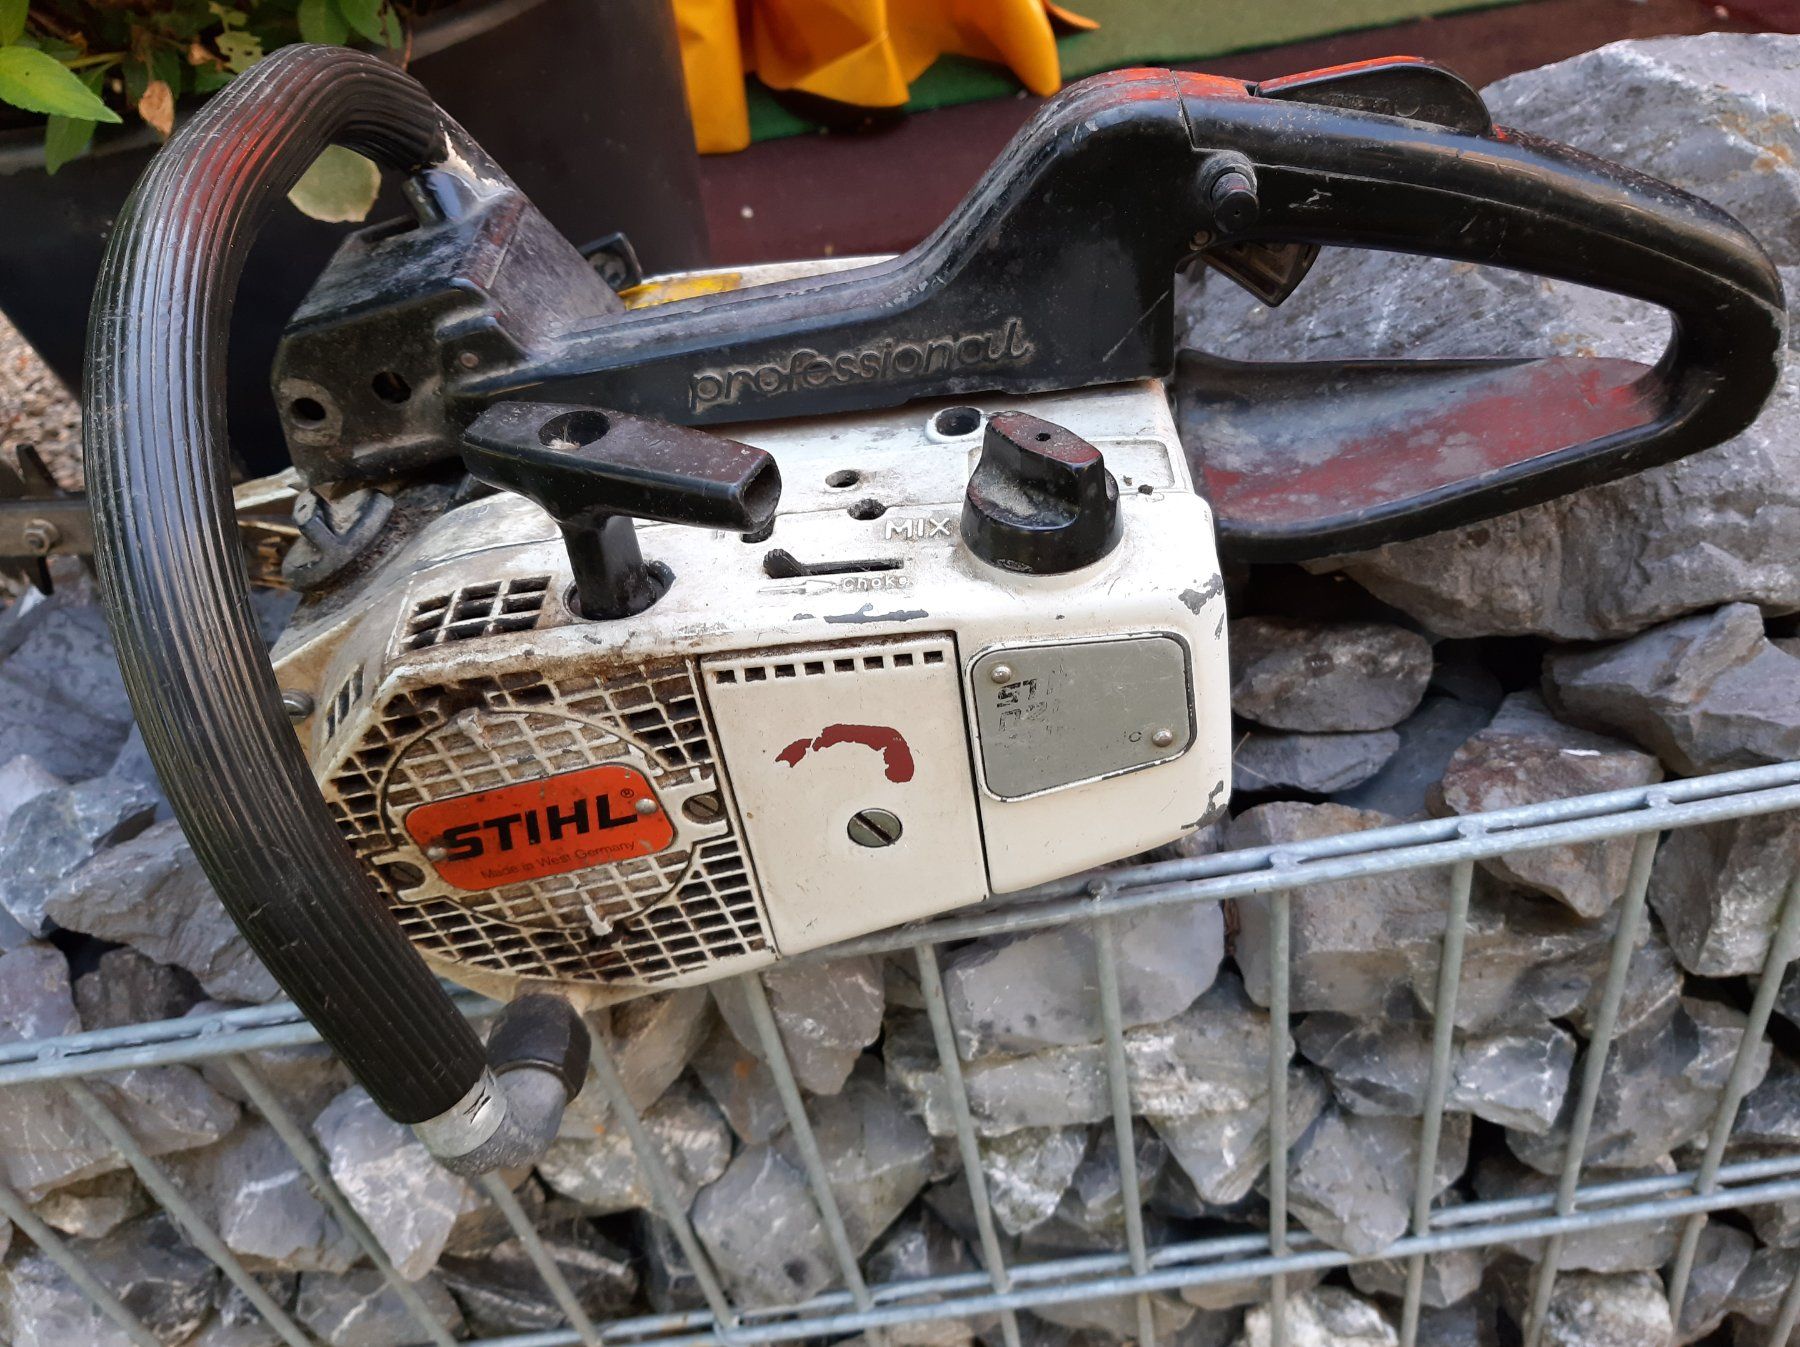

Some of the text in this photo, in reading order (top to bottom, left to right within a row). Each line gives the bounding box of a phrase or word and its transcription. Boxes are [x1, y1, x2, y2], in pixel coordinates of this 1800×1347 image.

[689, 317, 1034, 413] professional
[885, 517, 950, 540] MIX
[842, 574, 910, 591] Choke
[442, 792, 638, 862] STIHL
[480, 865, 519, 880] Made
[536, 853, 571, 867] West
[574, 841, 635, 859] Germany
